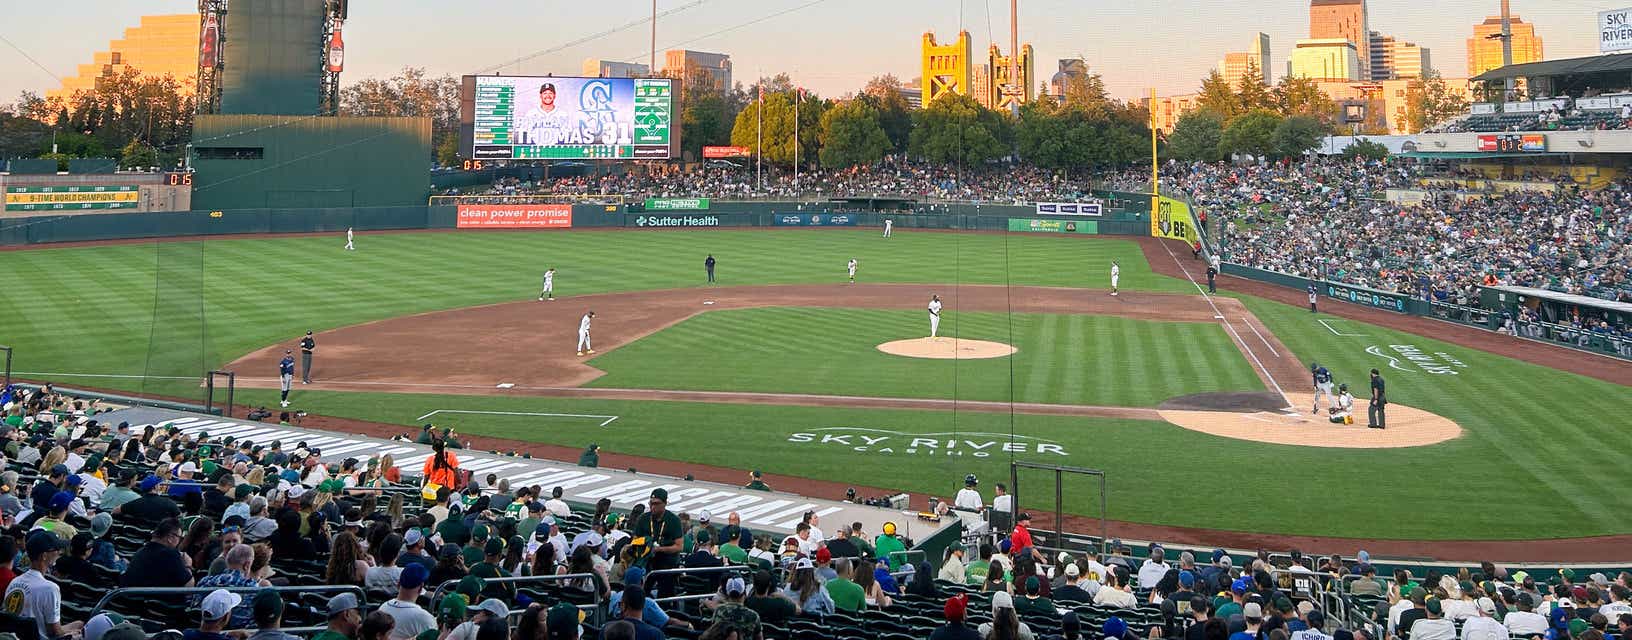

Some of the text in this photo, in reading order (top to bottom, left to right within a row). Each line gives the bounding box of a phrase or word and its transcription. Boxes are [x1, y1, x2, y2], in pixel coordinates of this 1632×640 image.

[1606, 12, 1627, 24] SKY
[1602, 29, 1632, 41] RIVER
[516, 122, 632, 145] THOMAS 31
[30, 194, 54, 202] 9-TIME
[78, 193, 116, 201] CHAMPIONS
[460, 208, 568, 219] clean power promise
[648, 216, 718, 226] Sutter Health
[1174, 221, 1184, 238] BE
[788, 432, 1070, 456] SKY RIVER
[853, 446, 990, 458] CASINO
[494, 467, 611, 493] FOR
[574, 480, 845, 529] BASEBALL
